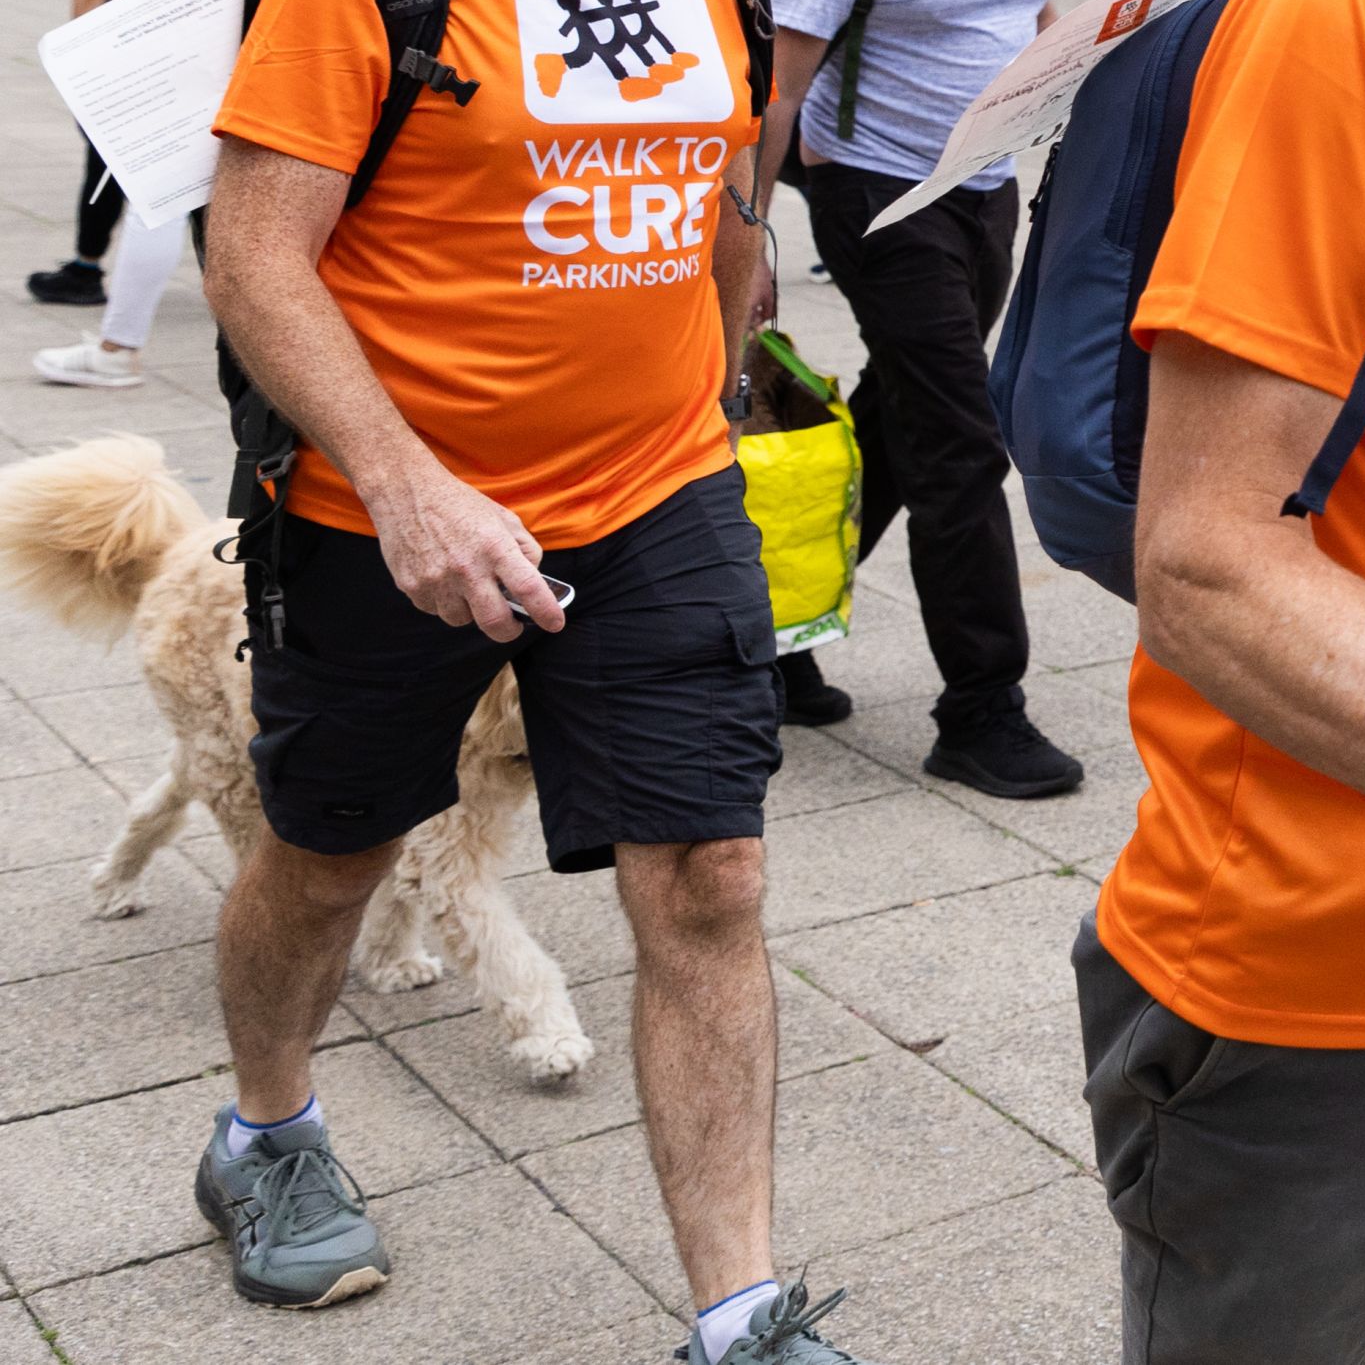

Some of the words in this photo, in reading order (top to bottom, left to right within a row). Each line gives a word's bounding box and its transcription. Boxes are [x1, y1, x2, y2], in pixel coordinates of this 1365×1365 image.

[525, 137, 668, 180] WALK
[674, 136, 728, 175] TO
[523, 182, 715, 255] CURE
[521, 253, 700, 289] PARKINSON'S
